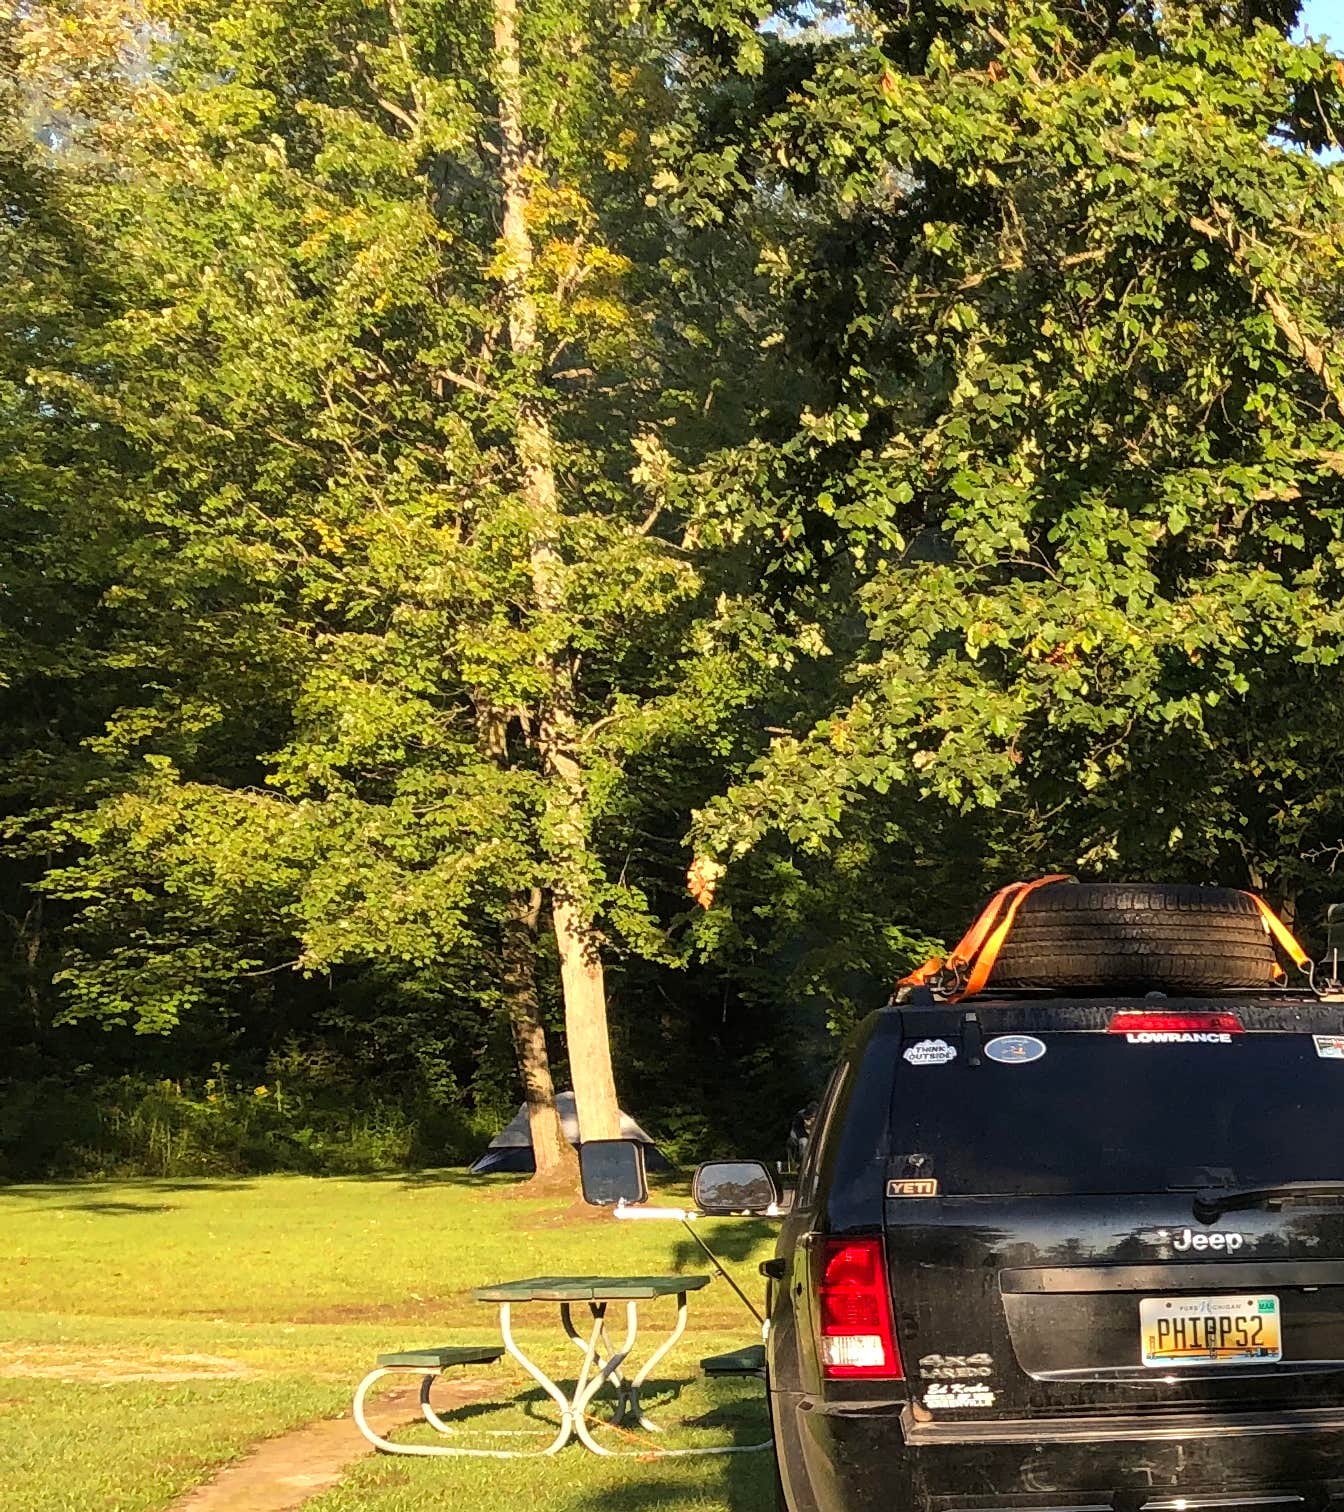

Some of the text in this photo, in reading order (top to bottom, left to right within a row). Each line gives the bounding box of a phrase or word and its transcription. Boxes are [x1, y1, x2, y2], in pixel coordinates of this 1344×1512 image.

[1126, 1033, 1232, 1043] LOWRANCE
[909, 1052, 952, 1060] OUTSIDE
[891, 1182, 931, 1193] YETI
[1173, 1229, 1243, 1254] Jeep
[1157, 1315, 1264, 1349] PHIPPS2
[920, 1367, 992, 1379] LAREDO
